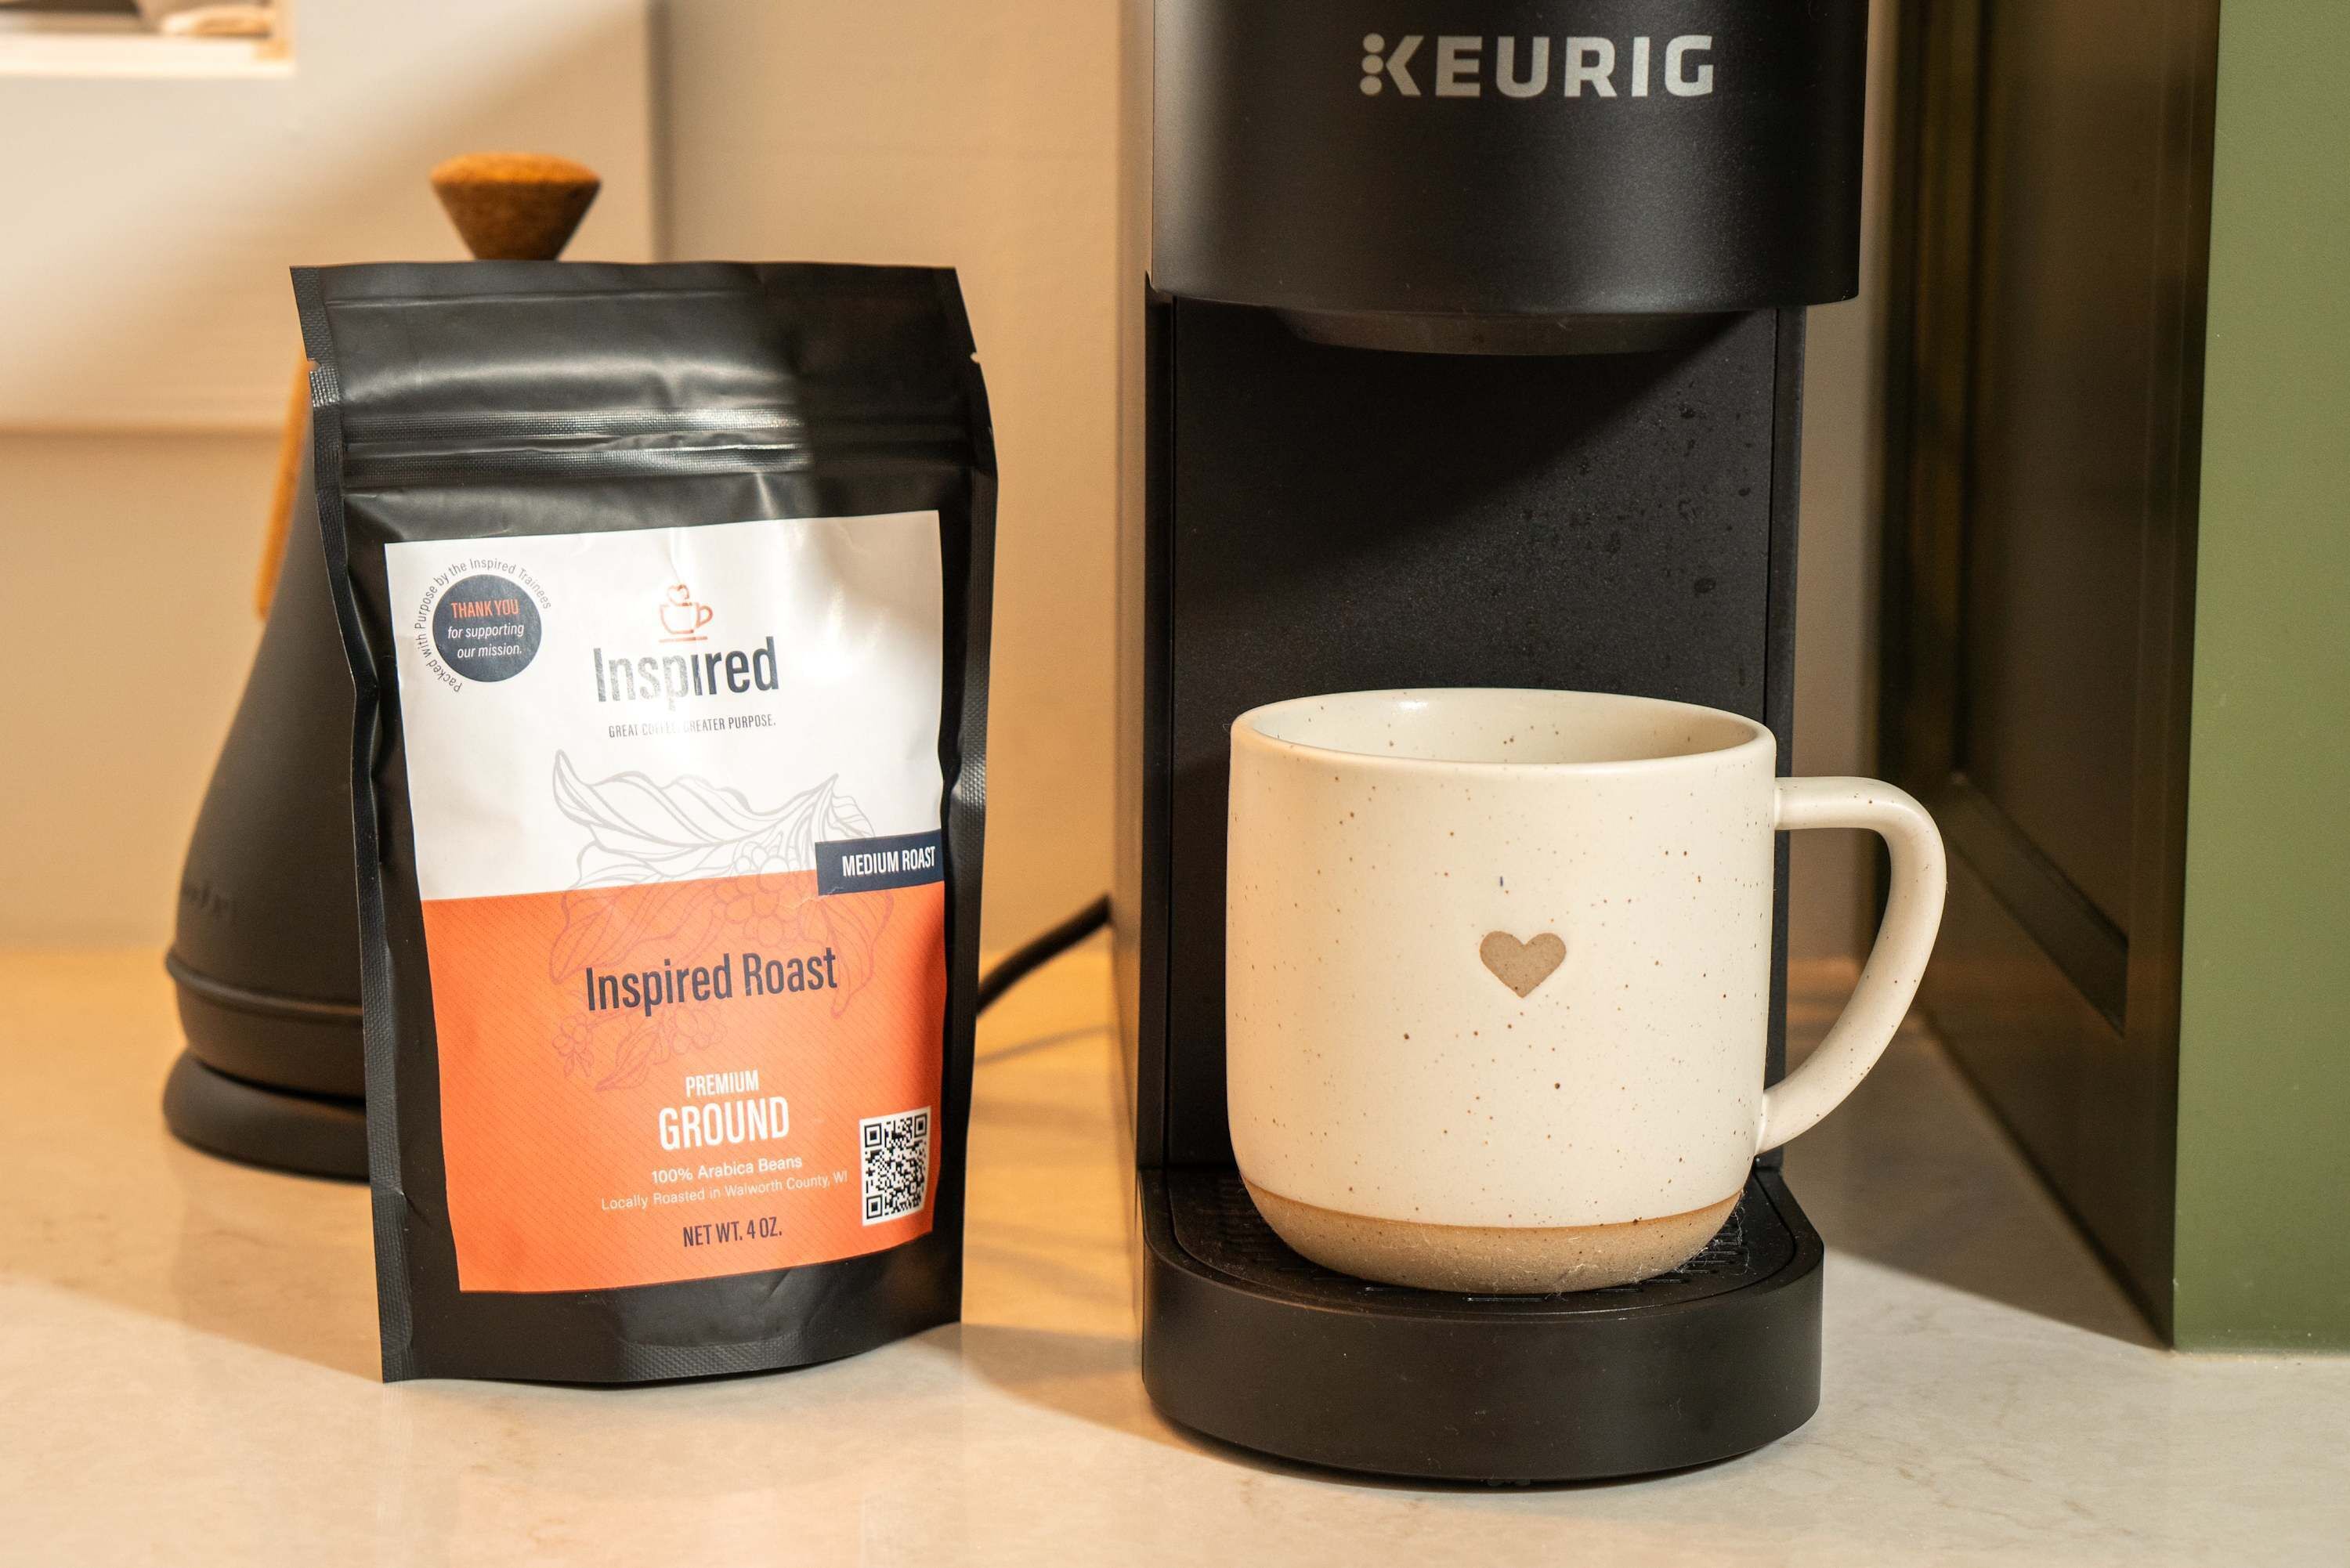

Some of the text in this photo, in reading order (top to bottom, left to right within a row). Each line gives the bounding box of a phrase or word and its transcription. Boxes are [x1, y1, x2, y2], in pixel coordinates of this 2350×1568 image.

[1360, 33, 1715, 98] KEURIG
[451, 599, 519, 619] THANK YOU
[414, 558, 551, 693] Packed with Purpose by the Inspired Trainees
[447, 623, 525, 639] for supporting
[457, 644, 522, 659] our mission.
[593, 636, 779, 712] Inspired
[609, 724, 638, 738] GREAT
[684, 717, 725, 733] GREATER
[728, 714, 776, 729] PURPOSE.
[841, 846, 936, 877] MEDIUM ROAST
[586, 947, 837, 1017] Inspired Roast
[685, 1070, 759, 1098] PREMIUM
[659, 1096, 790, 1151] GROUND
[652, 1156, 803, 1183] 100% Arabica Beans
[601, 1170, 848, 1211] Locally Roasted in Walworth County, WI
[683, 1216, 783, 1247] NET WT. 4 OZ.
